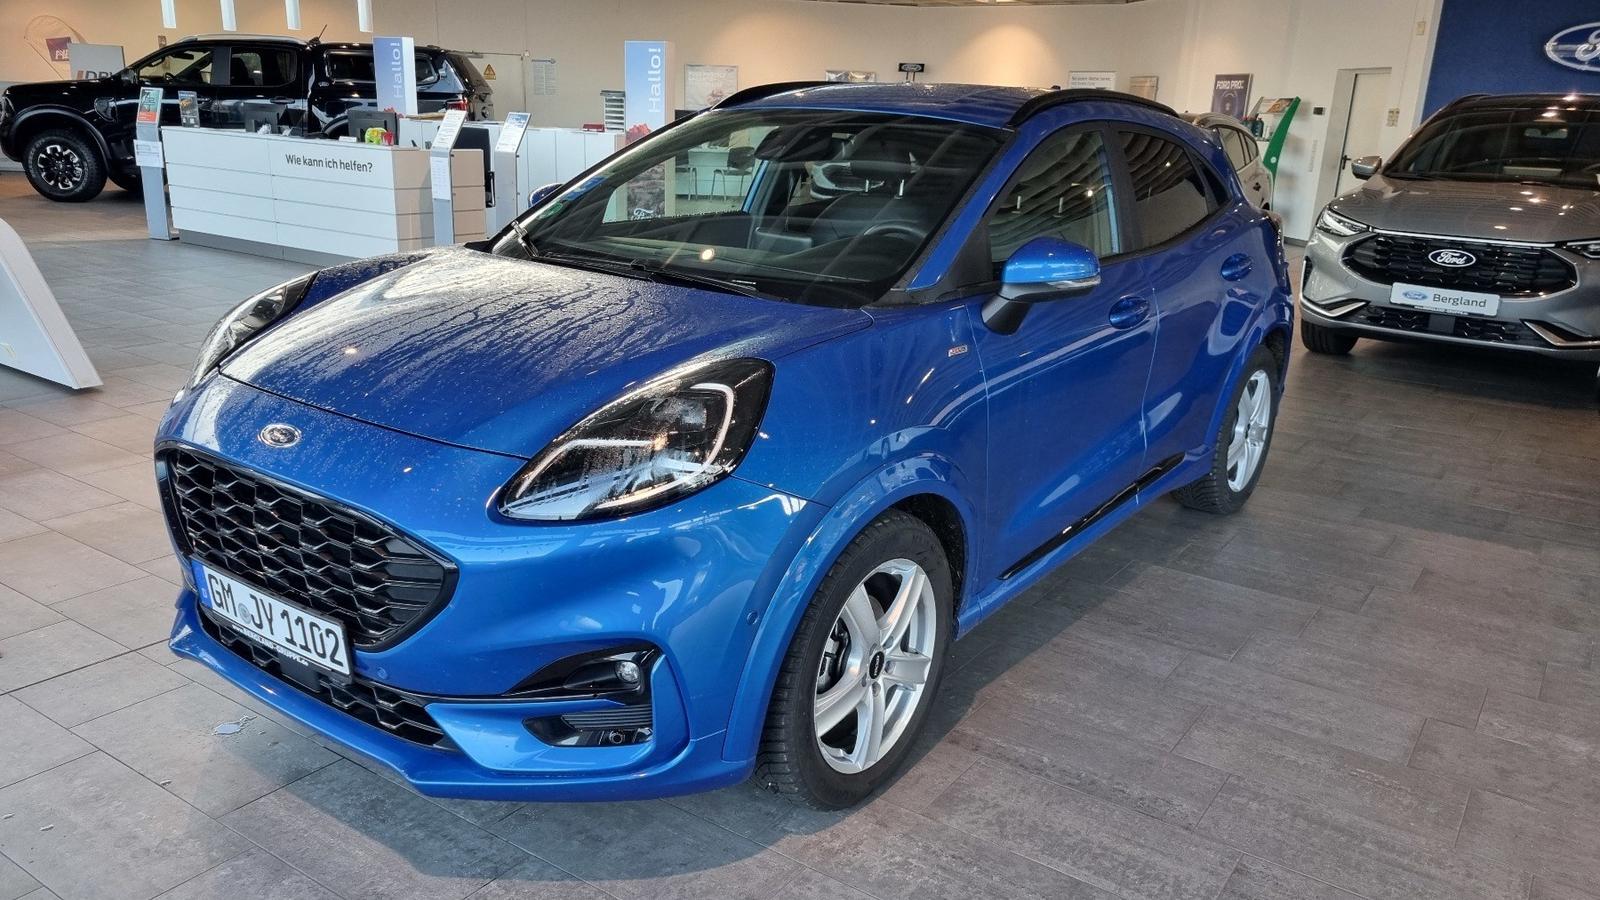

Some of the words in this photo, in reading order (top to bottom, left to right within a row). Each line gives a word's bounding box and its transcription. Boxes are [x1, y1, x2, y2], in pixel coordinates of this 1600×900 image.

[390, 42, 402, 98] Hallo!
[647, 47, 662, 112] Hallo!
[285, 153, 302, 165] Wie
[302, 155, 324, 167] kann
[324, 157, 338, 169] ich
[339, 159, 373, 173] helfen?
[1433, 293, 1487, 308] Bergland
[208, 573, 238, 618] GM
[249, 593, 275, 636] JY
[280, 609, 344, 667] 1102
